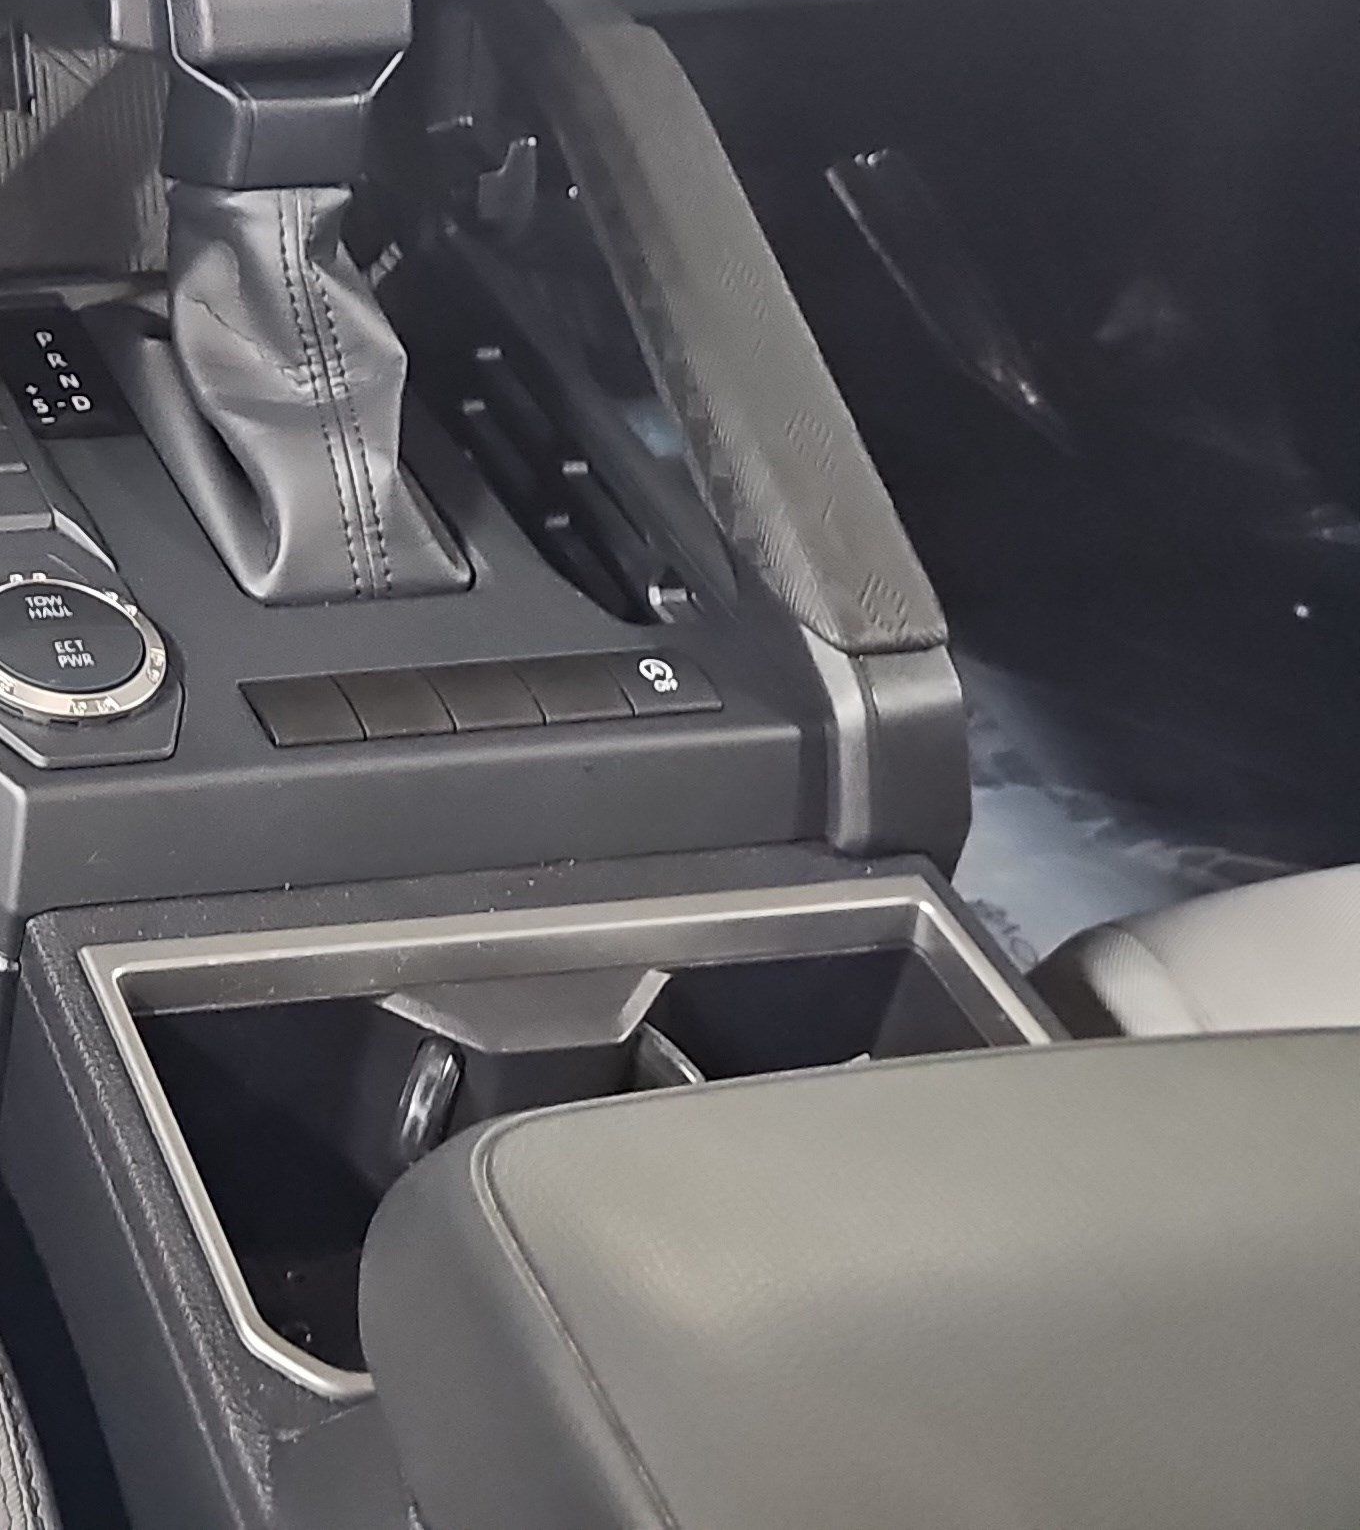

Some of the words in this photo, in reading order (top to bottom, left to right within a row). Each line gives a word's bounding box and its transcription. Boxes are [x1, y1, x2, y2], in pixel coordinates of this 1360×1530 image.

[35, 331, 53, 348] P
[46, 352, 68, 369] R
[59, 373, 80, 389] N
[32, 398, 49, 414] S
[71, 395, 91, 412] D
[24, 594, 63, 608] TOW
[28, 605, 73, 620] HAUL
[54, 639, 85, 654] ECT
[57, 652, 95, 669] PWR
